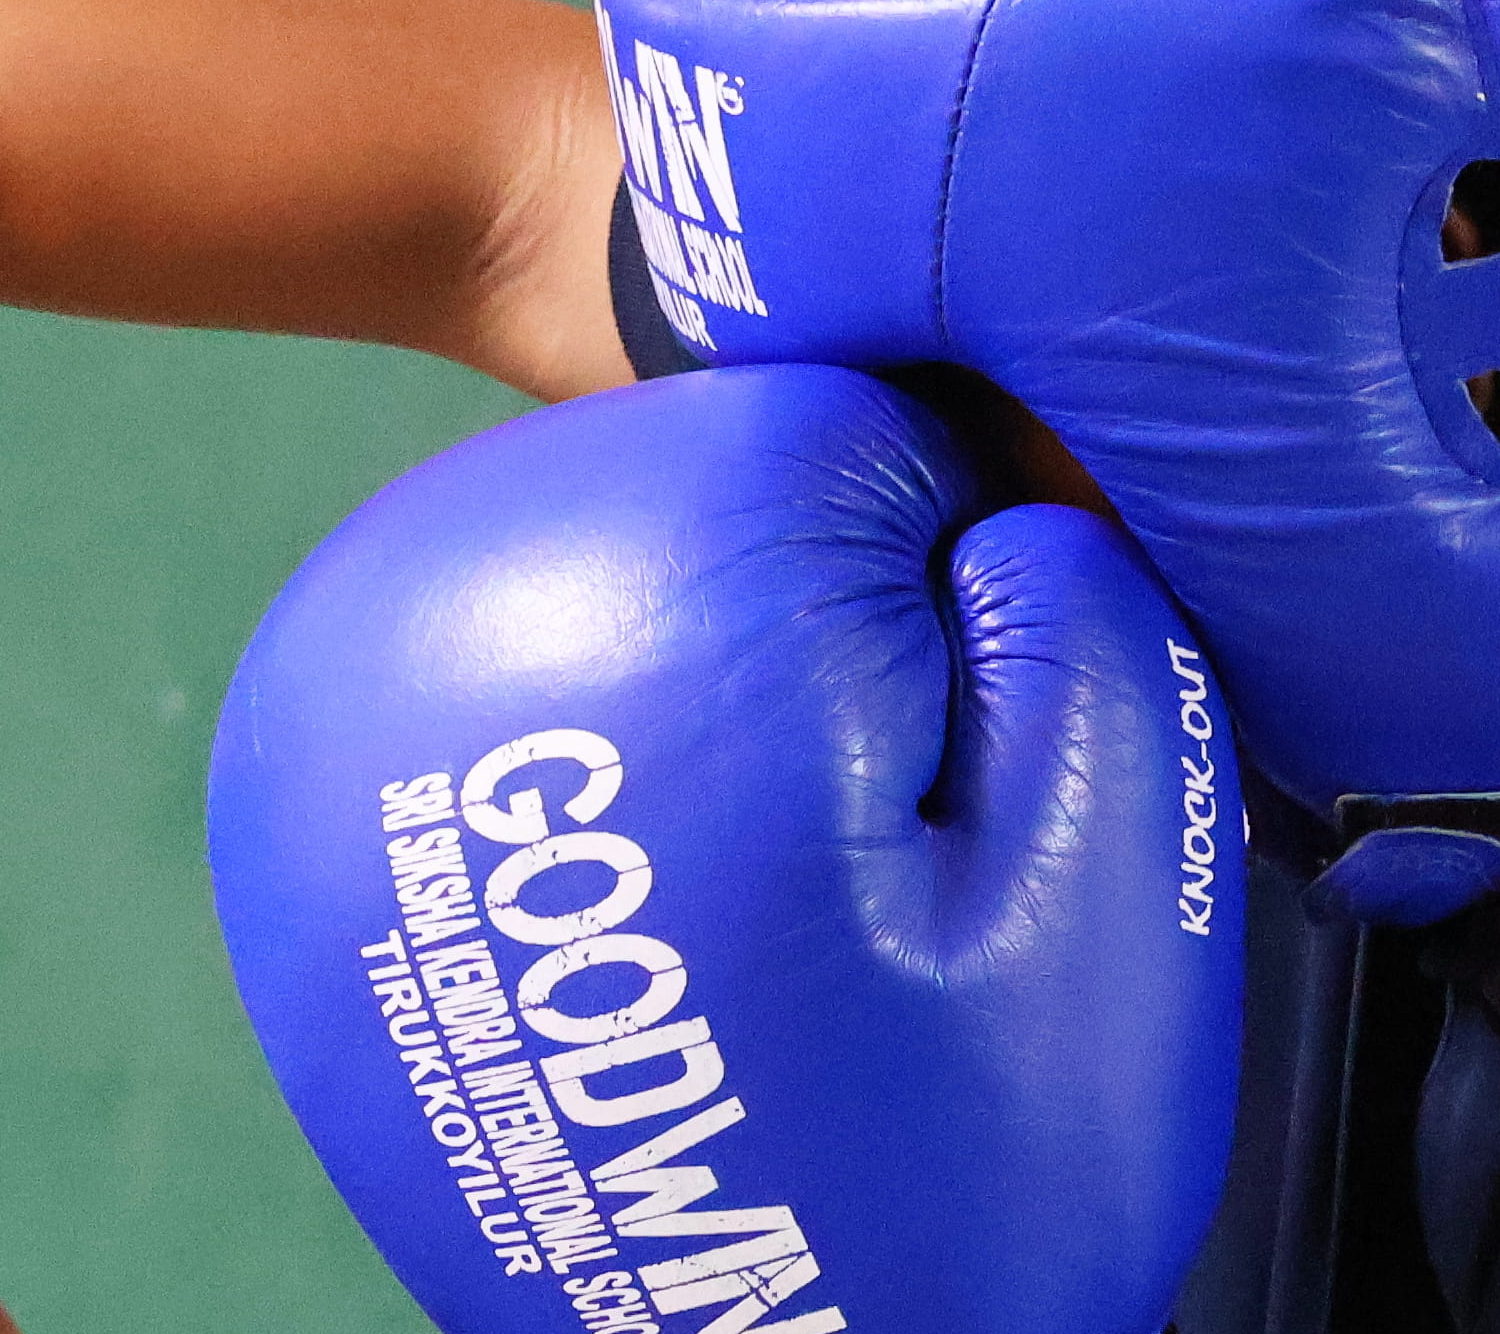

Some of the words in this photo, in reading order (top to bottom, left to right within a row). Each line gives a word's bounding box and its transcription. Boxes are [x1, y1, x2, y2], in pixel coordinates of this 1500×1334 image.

[379, 771, 454, 834] SRI
[1167, 638, 1216, 936] KNOCK-OUT
[384, 824, 484, 946] SIKSHA
[414, 930, 518, 1069] KENDRA
[360, 928, 543, 1277] TIRUKKOYILUR
[459, 1059, 620, 1275] INTERNATIONAL
